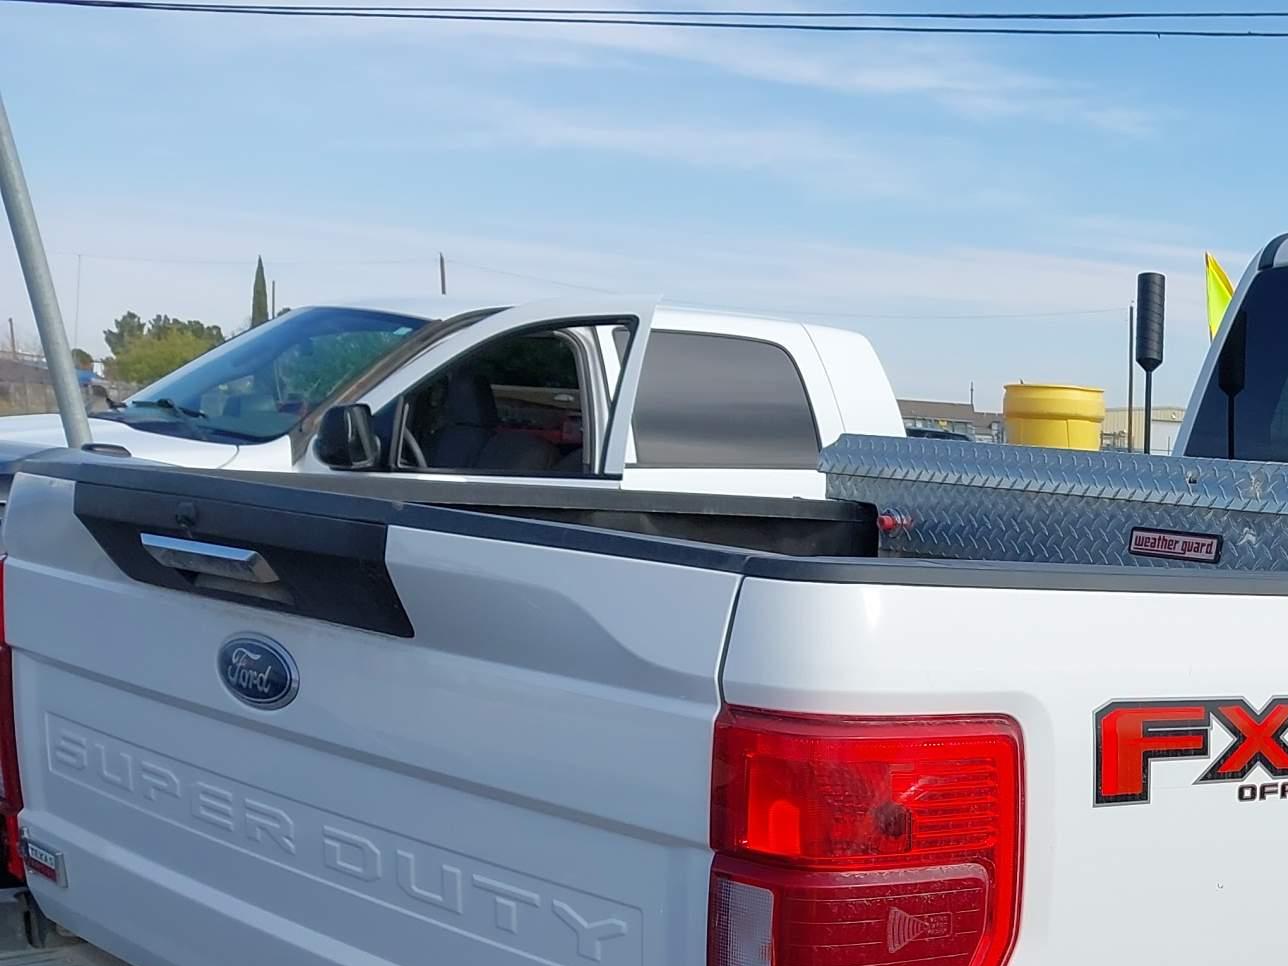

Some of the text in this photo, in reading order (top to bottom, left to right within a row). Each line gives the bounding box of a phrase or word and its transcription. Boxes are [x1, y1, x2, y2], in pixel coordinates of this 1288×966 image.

[1134, 535, 1214, 555] weather guard
[227, 647, 271, 694] Ford
[55, 729, 628, 961] SUPER DUTY
